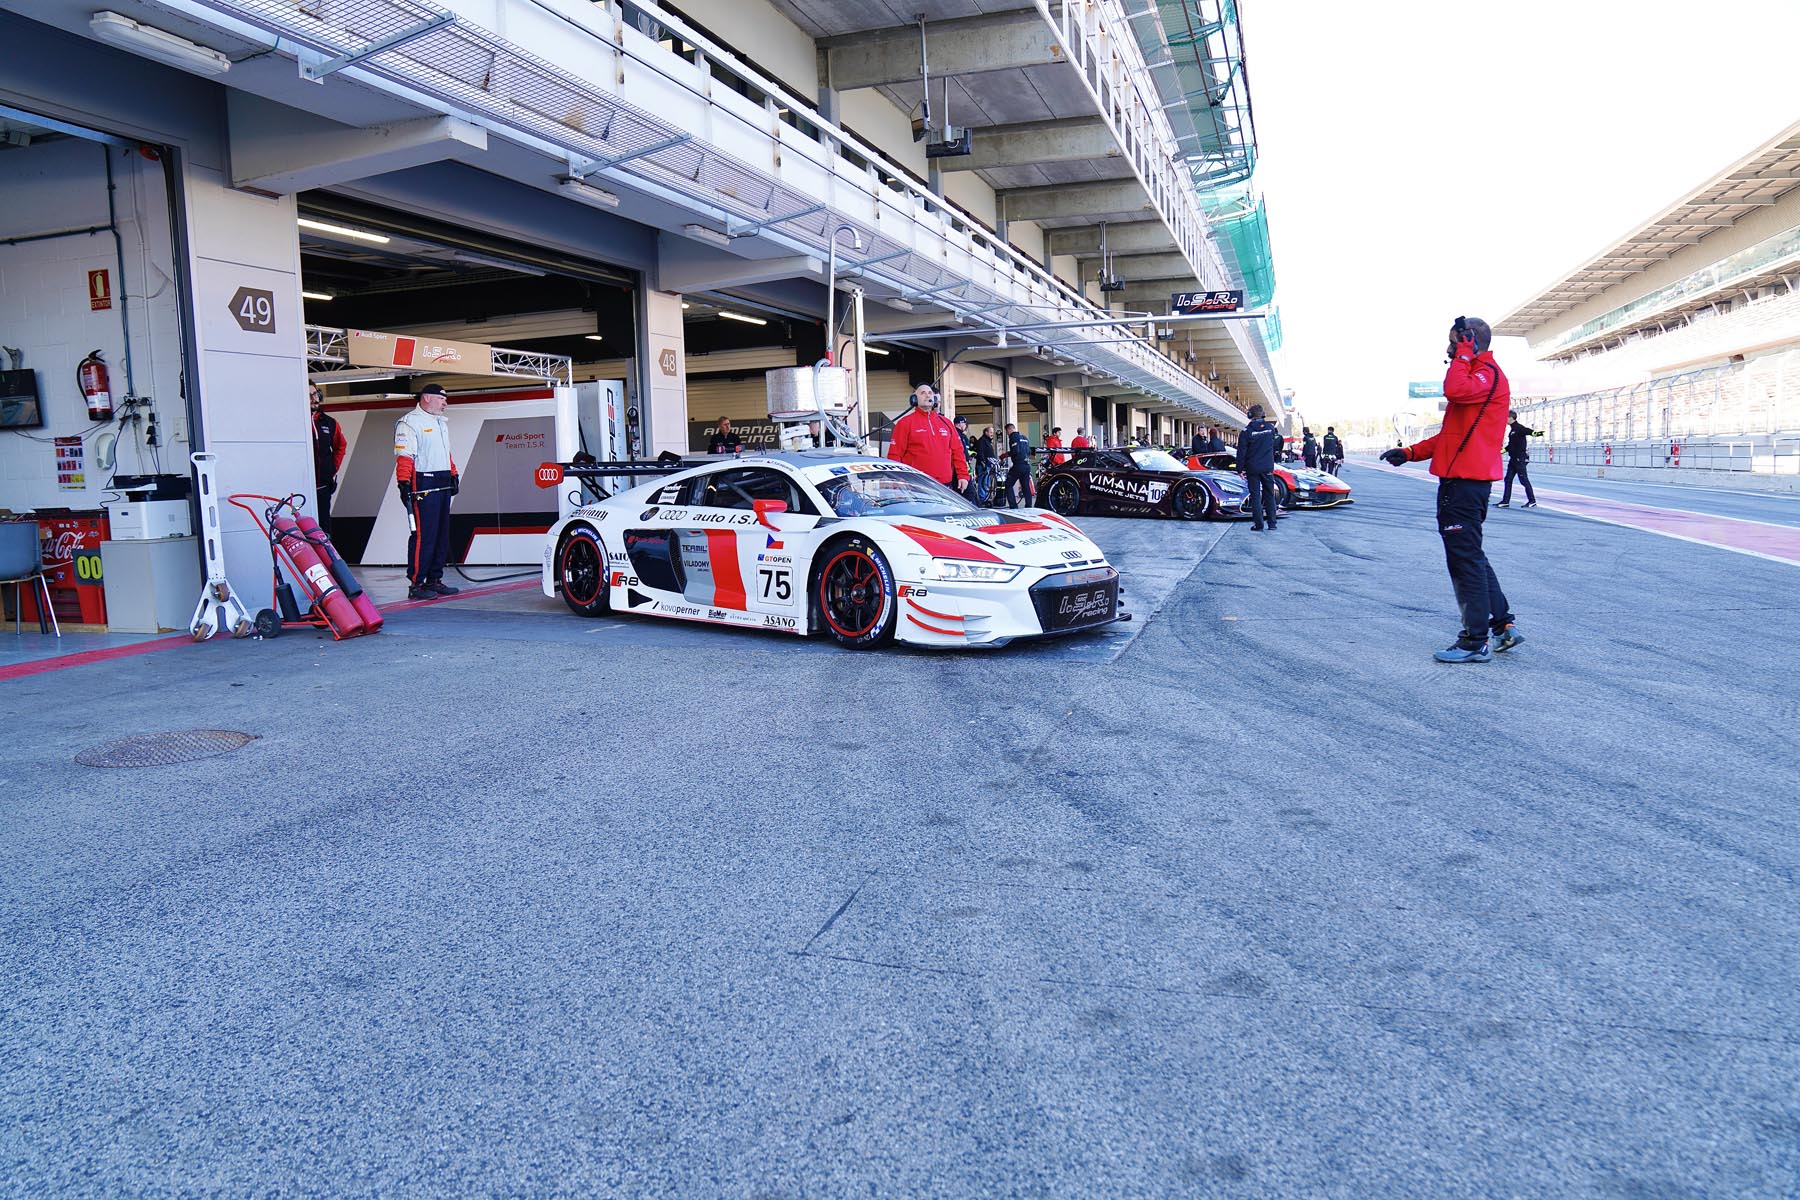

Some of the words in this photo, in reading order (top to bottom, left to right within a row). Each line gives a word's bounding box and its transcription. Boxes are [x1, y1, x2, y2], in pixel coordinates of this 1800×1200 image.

[240, 295, 271, 326] 49
[662, 353, 676, 372] 48
[524, 432, 545, 440] Sport
[1089, 472, 1149, 496] VIMANA
[1090, 485, 1124, 497] PRIVATE
[1124, 494, 1145, 502] JETS
[692, 512, 726, 524] auto
[77, 555, 103, 580] 00
[764, 555, 792, 564] GTOPEN
[617, 576, 639, 587] R8
[873, 556, 891, 593] MICHELIN
[759, 569, 791, 600] 75
[904, 588, 928, 597] R8
[660, 600, 701, 616] kovoperner
[763, 614, 796, 628] ASANO
